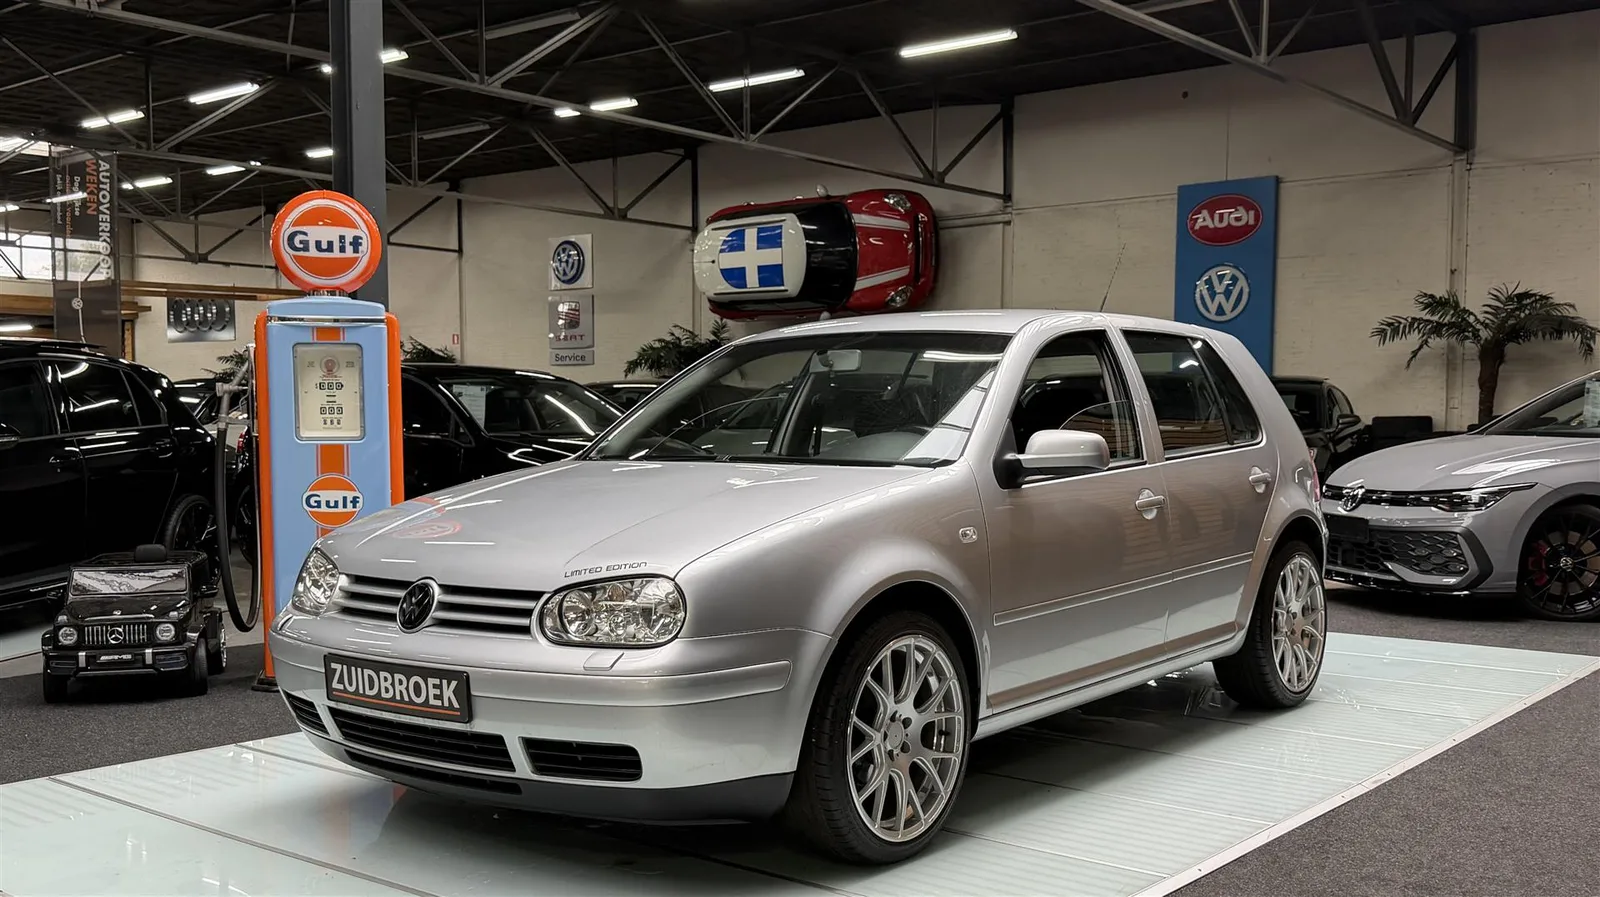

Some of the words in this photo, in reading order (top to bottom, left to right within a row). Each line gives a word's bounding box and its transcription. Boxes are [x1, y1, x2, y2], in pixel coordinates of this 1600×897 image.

[86, 159, 97, 215] WEKEN
[99, 160, 111, 280] AUTOVERKOOP
[287, 230, 364, 254] Gulf
[555, 353, 586, 362] Service
[305, 494, 360, 509] Gulf
[564, 566, 602, 578] LIMITED
[606, 561, 647, 571] EDITION
[331, 663, 460, 708] ZUIDBROEK
